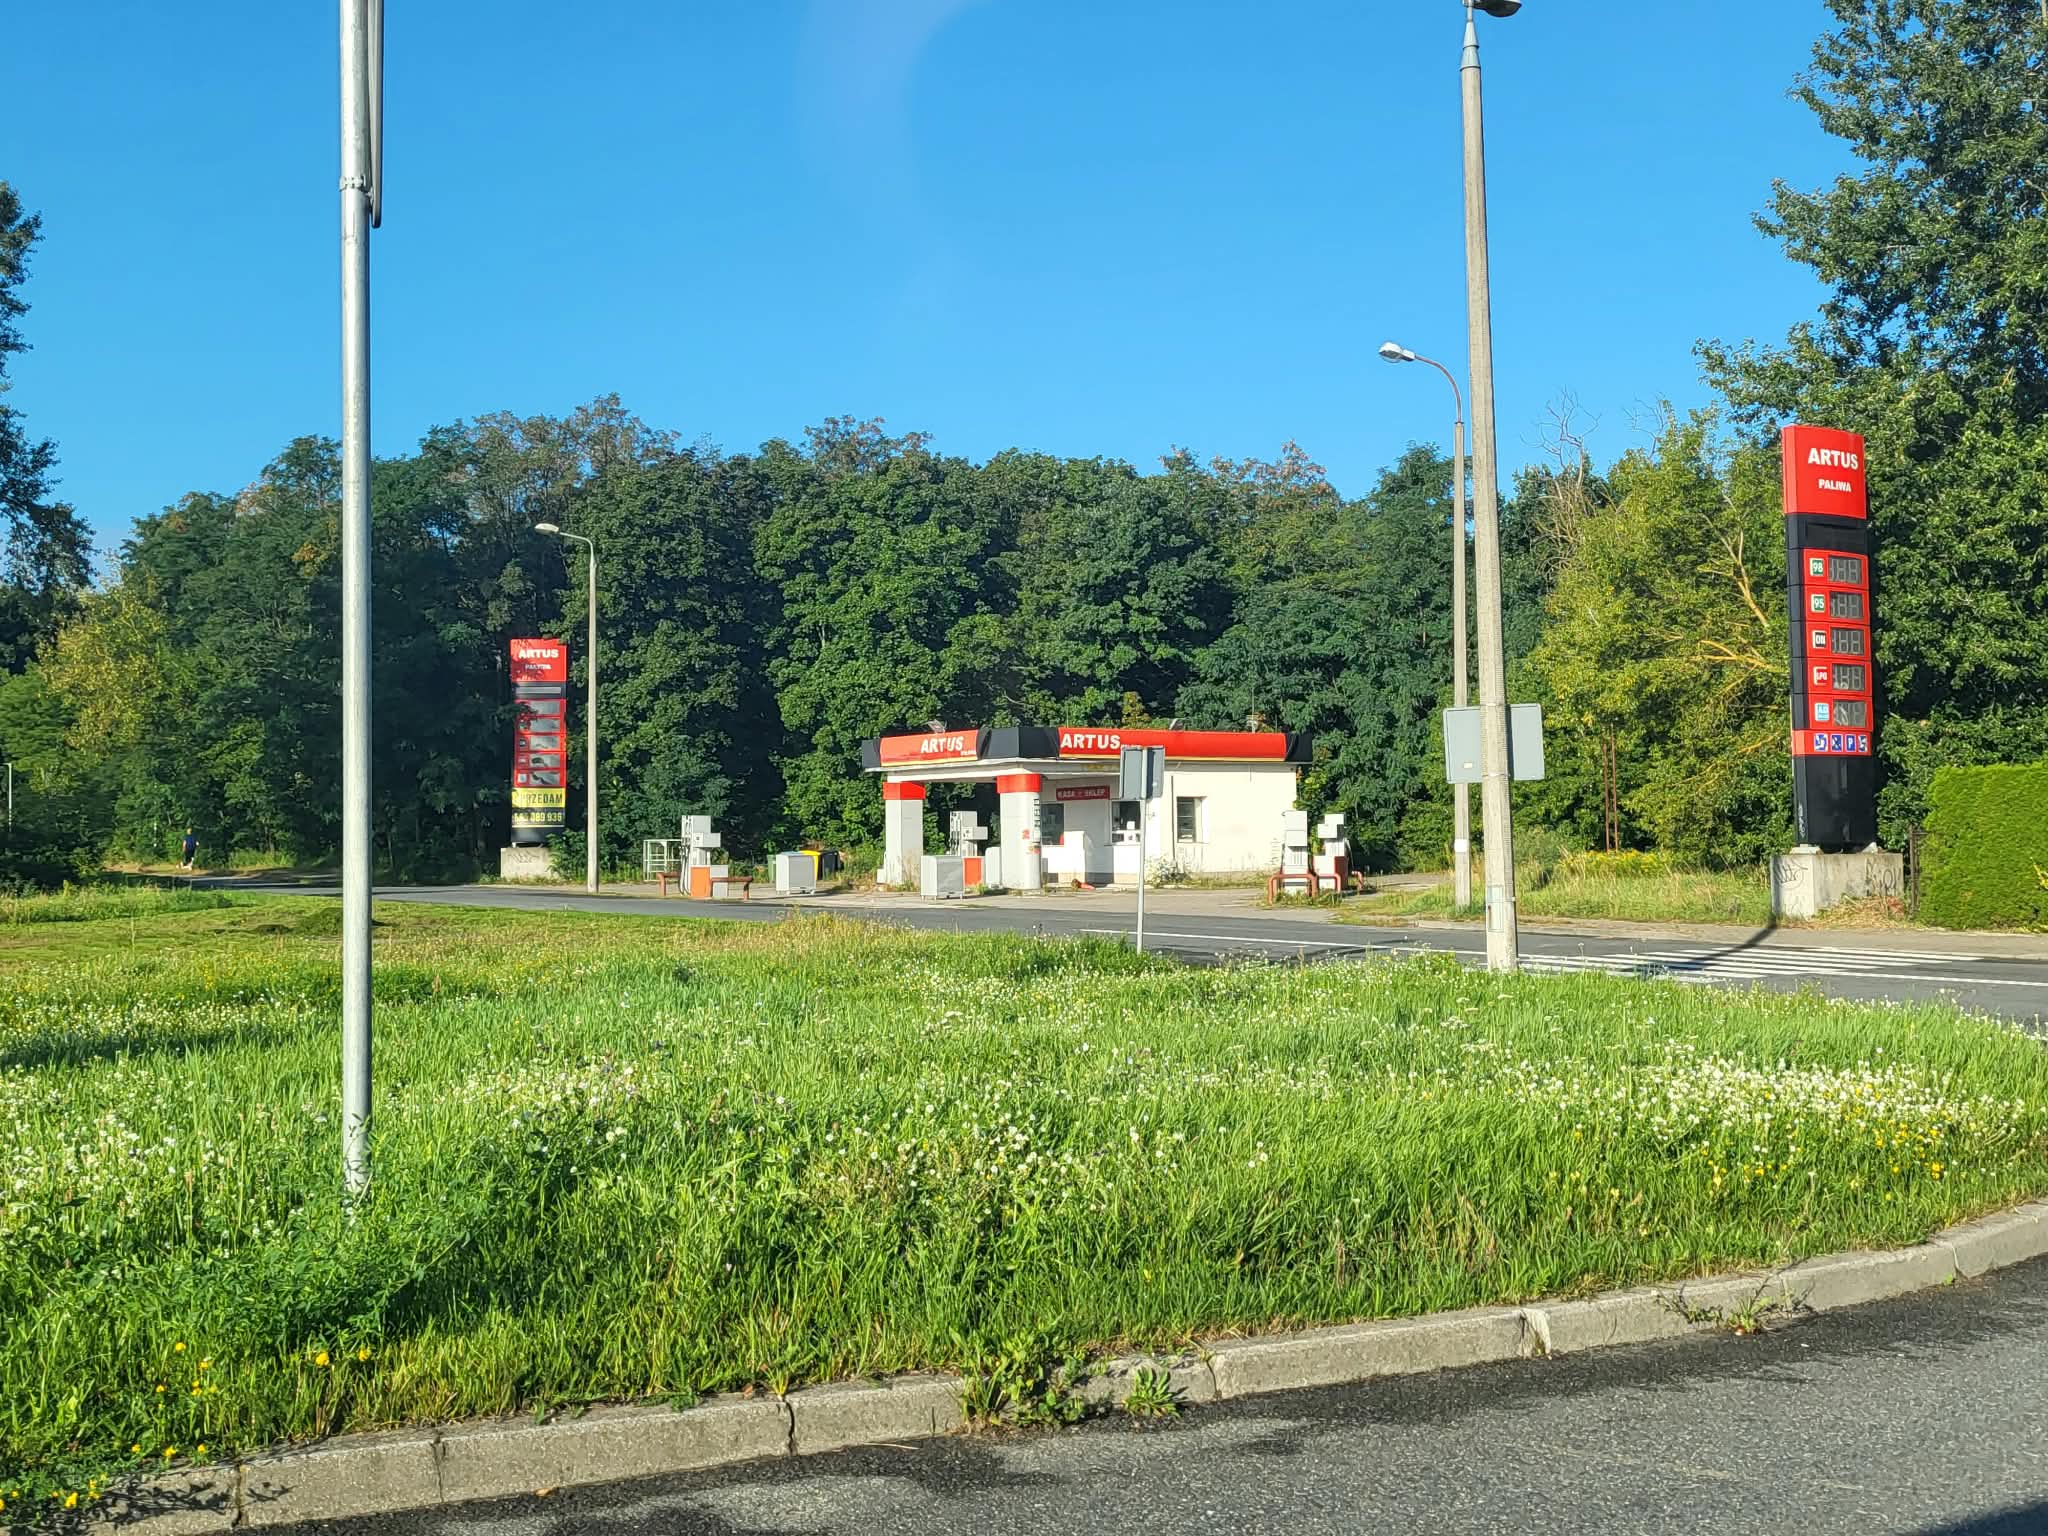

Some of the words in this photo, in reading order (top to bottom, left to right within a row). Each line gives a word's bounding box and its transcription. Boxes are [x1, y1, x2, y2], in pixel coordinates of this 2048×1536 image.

[1807, 448, 1858, 470] ARTUS
[1818, 478, 1852, 492] PALIWA
[1813, 562, 1823, 573] 98
[1814, 598, 1824, 609] 95
[1815, 635, 1825, 645] ON
[518, 649, 559, 659] ARTUS
[920, 736, 964, 753] ARTUS
[1060, 733, 1121, 749] ARTUS
